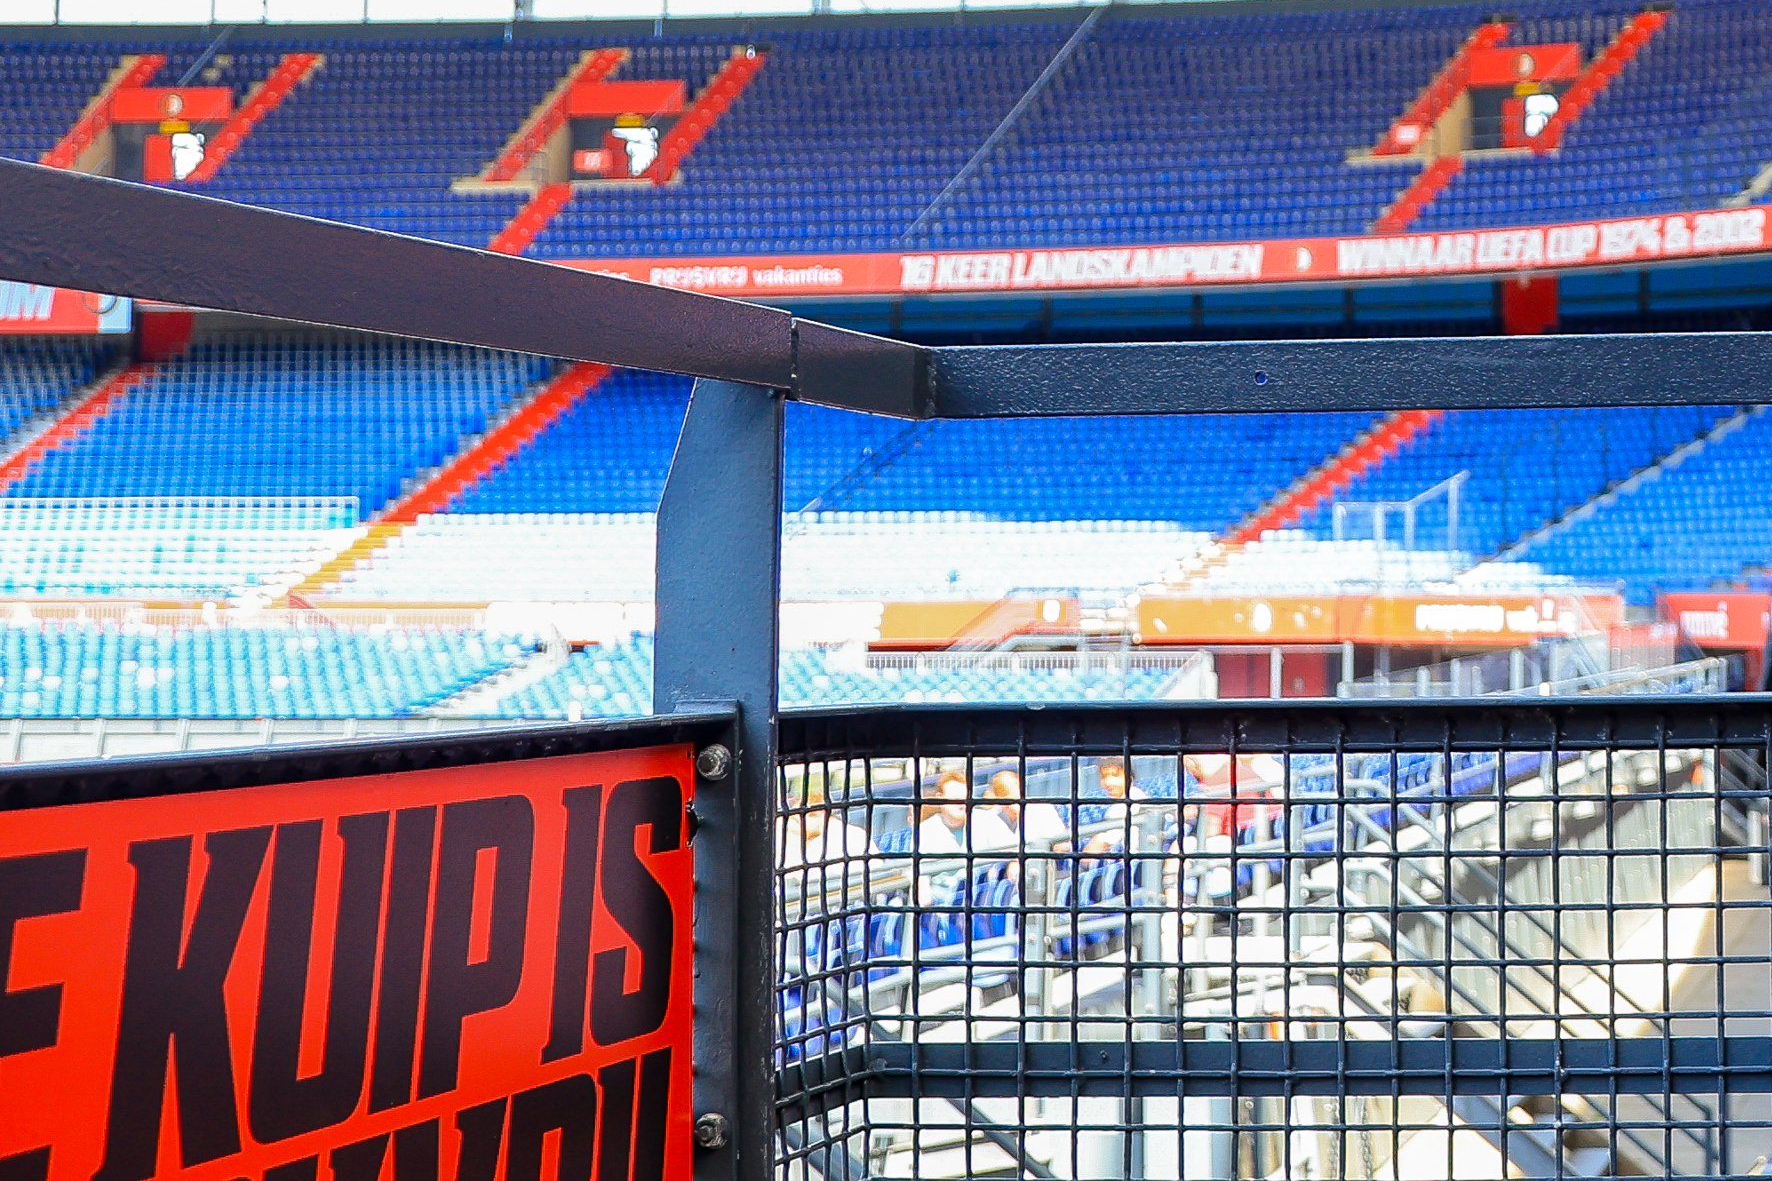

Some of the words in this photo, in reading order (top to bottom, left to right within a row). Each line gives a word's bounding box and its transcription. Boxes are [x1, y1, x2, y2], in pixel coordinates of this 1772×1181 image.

[1476, 228, 1543, 267] UEFA
[1546, 224, 1598, 261] CUP
[1664, 215, 1692, 252] &
[751, 264, 844, 286] vakanties
[935, 251, 1012, 288] KEER
[1013, 243, 1264, 284] LANDSKAMPIOEN
[92, 793, 535, 1181] KUIP
[540, 776, 684, 1066] IS
